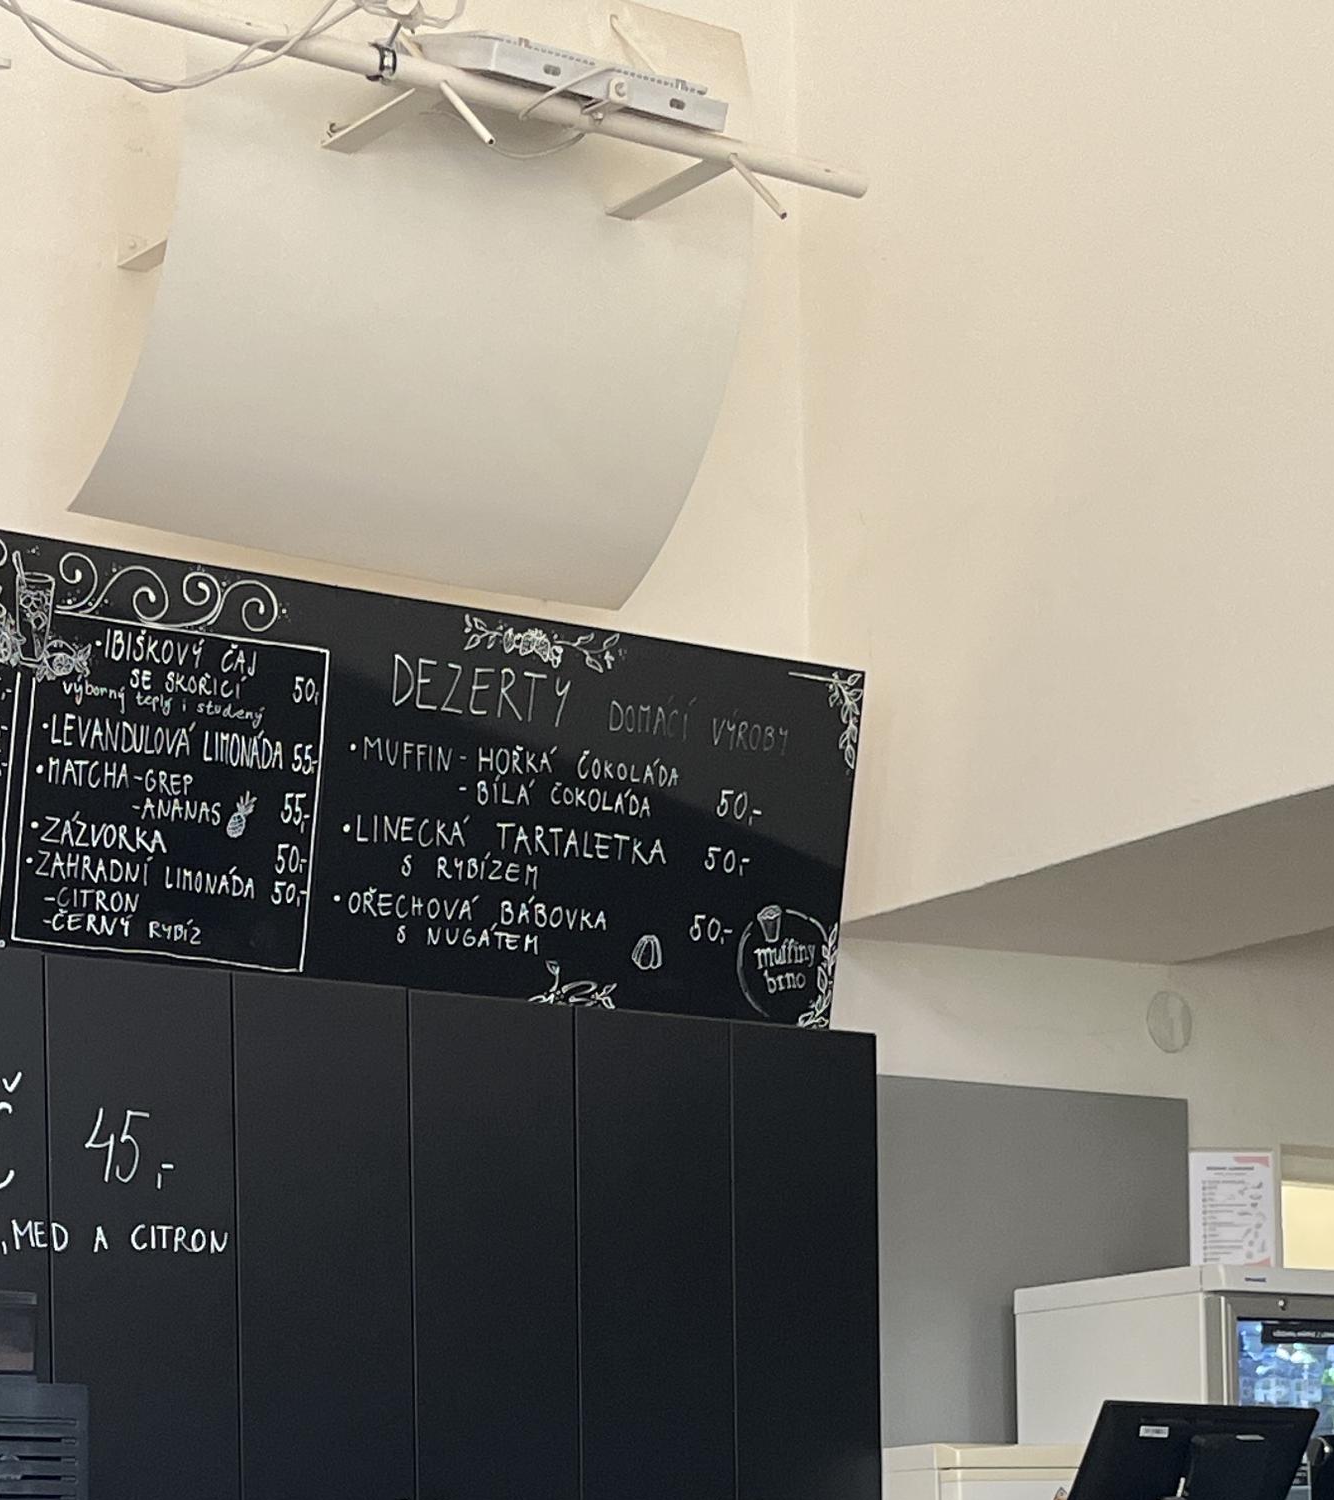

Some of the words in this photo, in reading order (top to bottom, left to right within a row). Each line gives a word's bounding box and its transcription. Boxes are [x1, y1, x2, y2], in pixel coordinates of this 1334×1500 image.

[104, 628, 205, 669] IBIŠKOVÝ
[221, 643, 257, 677] ČAJ
[62, 673, 126, 715] výborný
[182, 703, 187, 712] i
[196, 700, 266, 729] studený
[129, 668, 152, 691] SE
[164, 670, 247, 699] SKOŘICÍ
[392, 653, 571, 728] DEZERTY
[608, 696, 697, 740] DOMÁCÍ
[712, 717, 789, 752] VÝROBY
[50, 712, 196, 758] LEVANDULOVÁ
[203, 729, 283, 770] LIMONÁDA
[363, 735, 453, 772] MUFFIN
[577, 749, 679, 787] ČOKOLÁDA
[48, 756, 128, 789] MATCHA
[280, 792, 311, 834] 55,-
[476, 774, 535, 806] BÍLÁ
[550, 786, 651, 818] ČOKOLÁDA
[716, 789, 762, 826] 50,-
[40, 810, 167, 854] ZÁZVORKA
[356, 814, 470, 848] LINECKÁ
[496, 822, 667, 866] TARTALETKA
[704, 846, 751, 876] 50,-
[35, 849, 154, 886] ZAHRADNÍ
[165, 865, 255, 899] LIMONÁDA
[437, 851, 538, 890] RYBÍZEM
[148, 918, 201, 945] RYBÍZ
[348, 886, 480, 921] OŘECHOVÁ
[500, 895, 607, 931] BÁBOVKA
[689, 914, 733, 945] 50,-
[427, 922, 539, 955] NUGÁTEM
[753, 937, 816, 970] muffiny
[763, 969, 806, 994] brno
[84, 1107, 174, 1190] 45,-
[93, 1225, 109, 1253] A
[130, 1223, 228, 1254] CITRON
